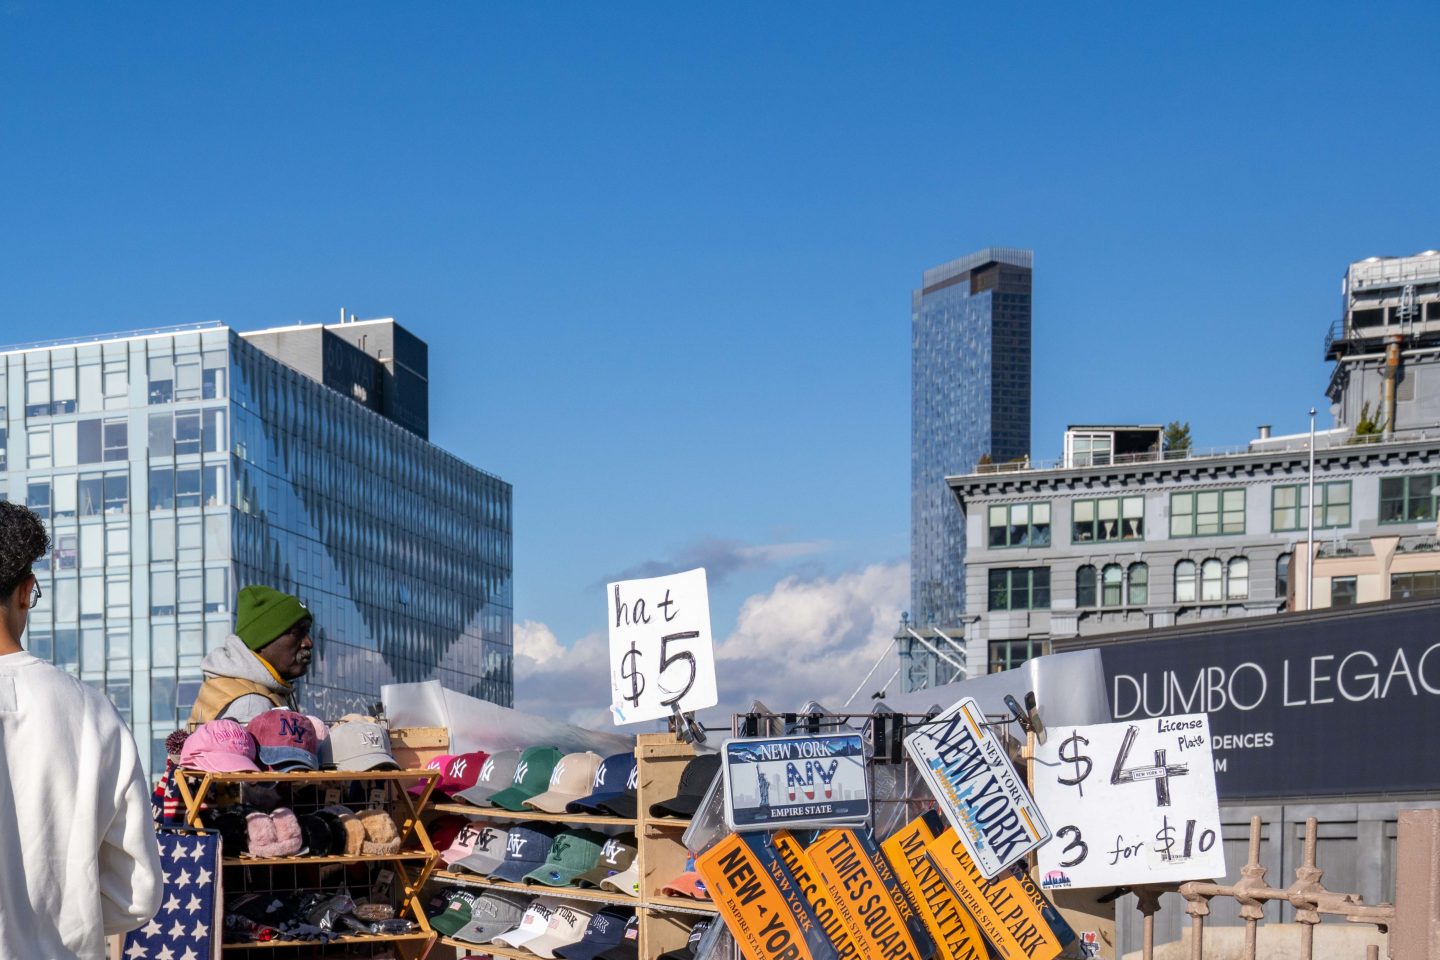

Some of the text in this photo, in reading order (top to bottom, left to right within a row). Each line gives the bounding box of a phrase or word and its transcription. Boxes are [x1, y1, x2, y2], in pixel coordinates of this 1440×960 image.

[615, 584, 680, 627] hat
[621, 630, 700, 708] $5
[1114, 662, 1268, 719] DUMBO
[279, 718, 306, 744] NY
[760, 741, 832, 761] NEW YORK
[1158, 719, 1203, 733] License
[1178, 735, 1205, 752] Plate
[1212, 732, 1274, 750] DENCES
[786, 759, 839, 802] NY
[928, 712, 1032, 865] NEW YORK
[983, 740, 1025, 807] NEW YORK
[770, 804, 833, 818] EMPIRE STATE
[826, 832, 873, 901] TIMES
[1056, 815, 1216, 868] 3 for $10
[718, 846, 766, 907] NEW
[768, 859, 814, 933] NEW YORK
[870, 851, 914, 922] NEW YORK
[1019, 873, 1049, 915] YORK
[559, 907, 578, 928] YORK
[727, 899, 749, 934] EMPIRE
[829, 885, 871, 954] EMPIRE STATE
[955, 880, 1005, 946] EMPIRE STATE
[1007, 904, 1047, 959] PARK
